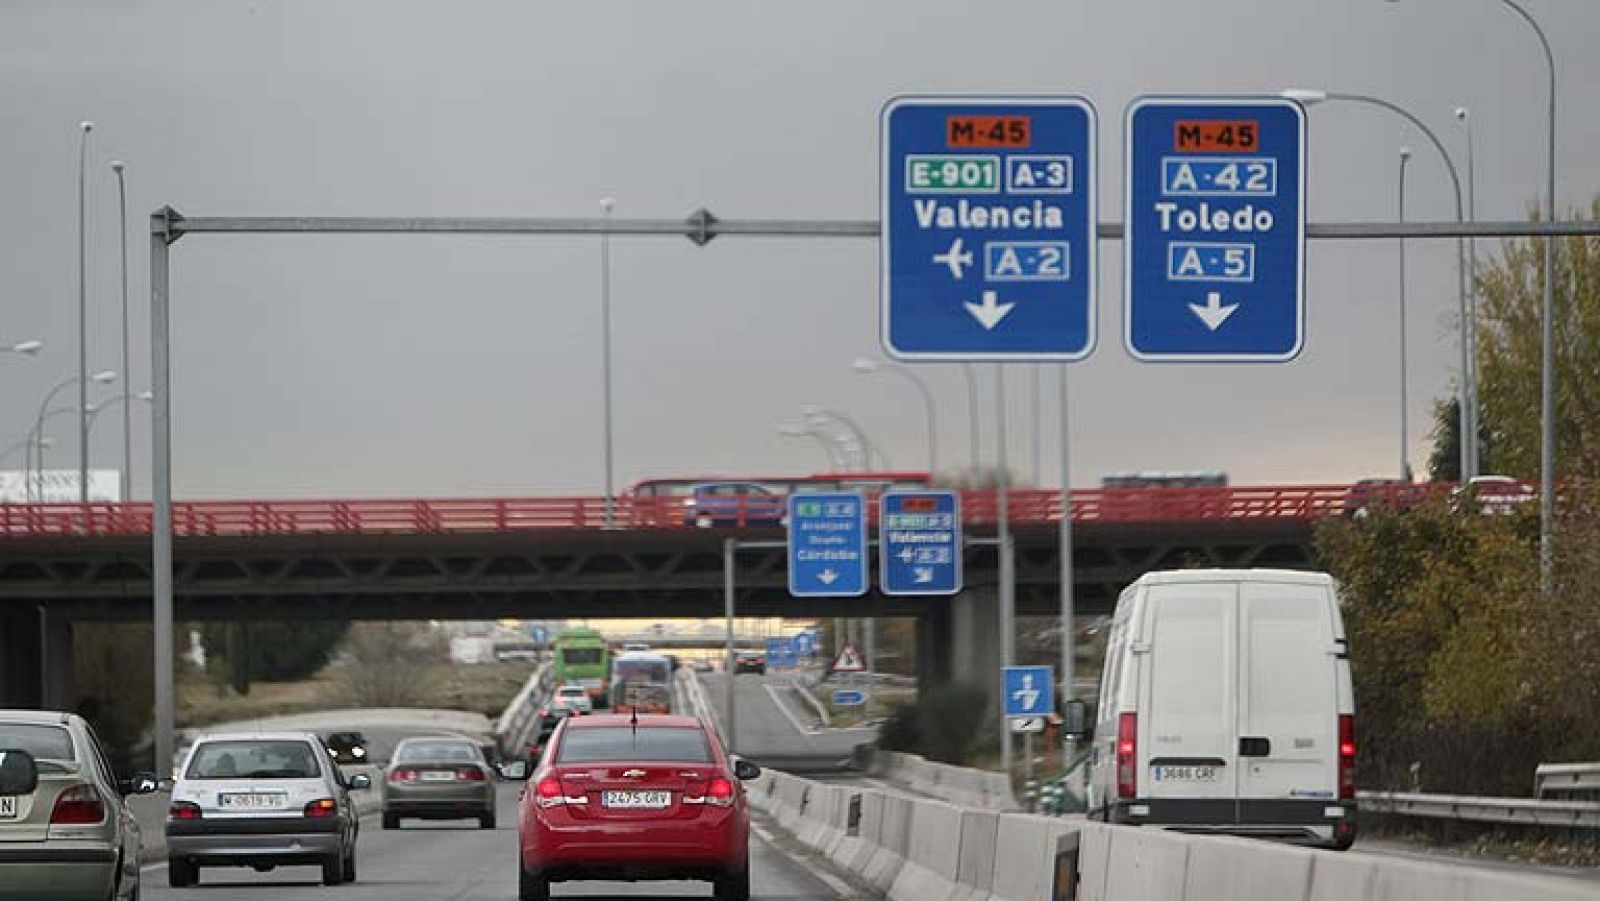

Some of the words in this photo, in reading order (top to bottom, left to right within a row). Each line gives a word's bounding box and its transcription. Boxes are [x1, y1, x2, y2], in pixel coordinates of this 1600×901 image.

[951, 121, 1025, 143] M-45
[1178, 125, 1254, 148] M-45
[911, 162, 994, 187] E-901
[1014, 162, 1067, 187] A-3
[1172, 162, 1269, 190] A-42
[913, 199, 1063, 229] Valencia
[1155, 202, 1274, 232] Toledo
[995, 246, 1061, 275] A-2
[1177, 247, 1245, 276] A-5
